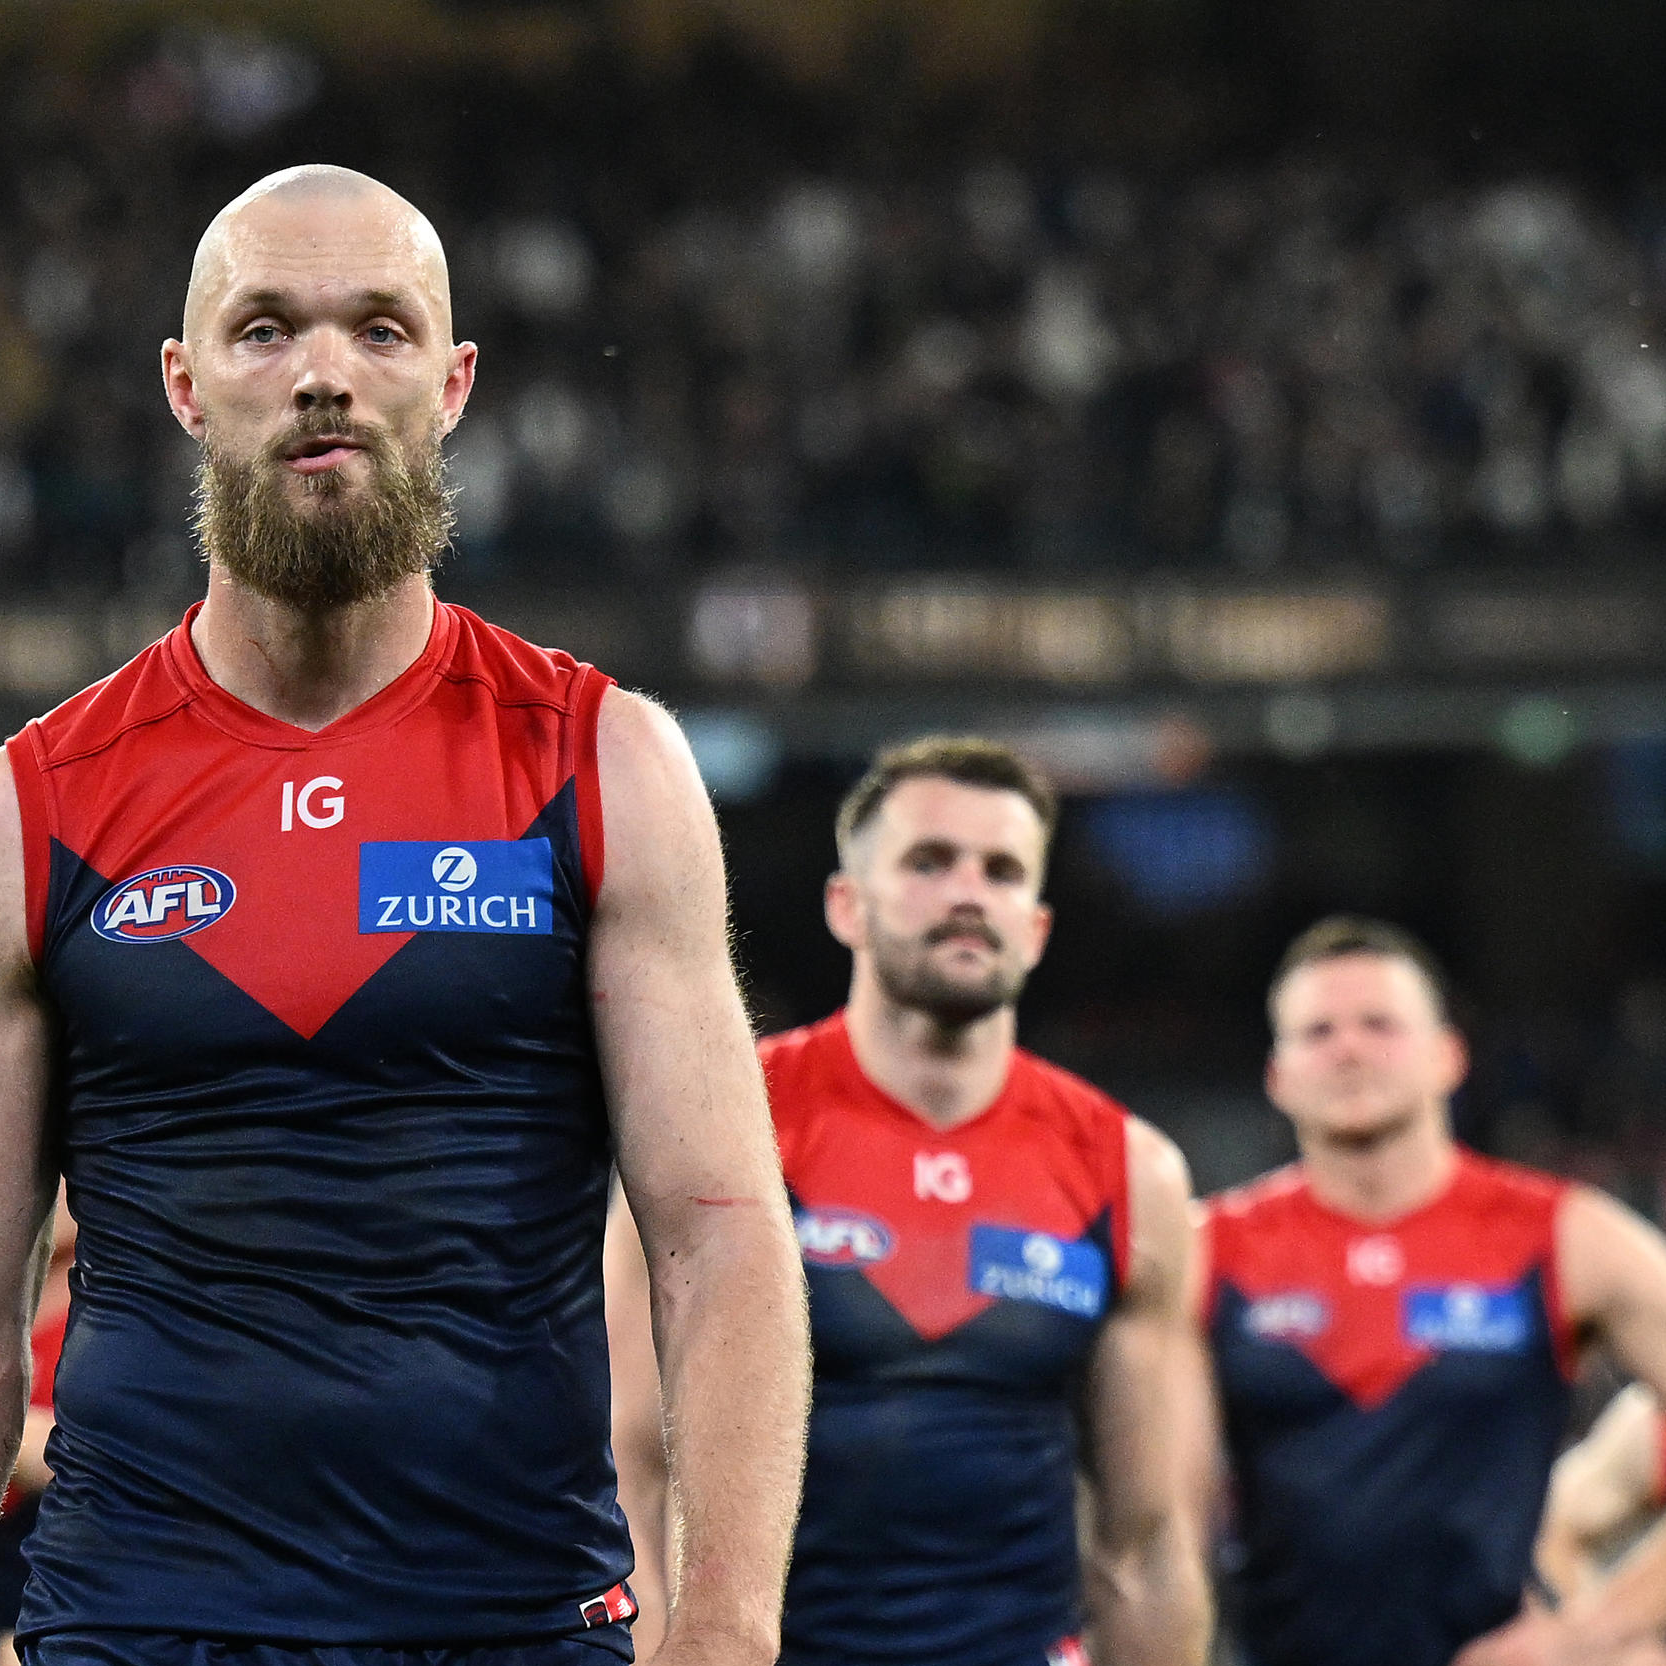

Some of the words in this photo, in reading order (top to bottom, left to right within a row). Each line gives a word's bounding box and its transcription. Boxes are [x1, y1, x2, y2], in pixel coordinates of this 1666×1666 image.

[280, 775, 345, 832] IG
[102, 879, 221, 930] AFL
[375, 895, 537, 928] ZURICH
